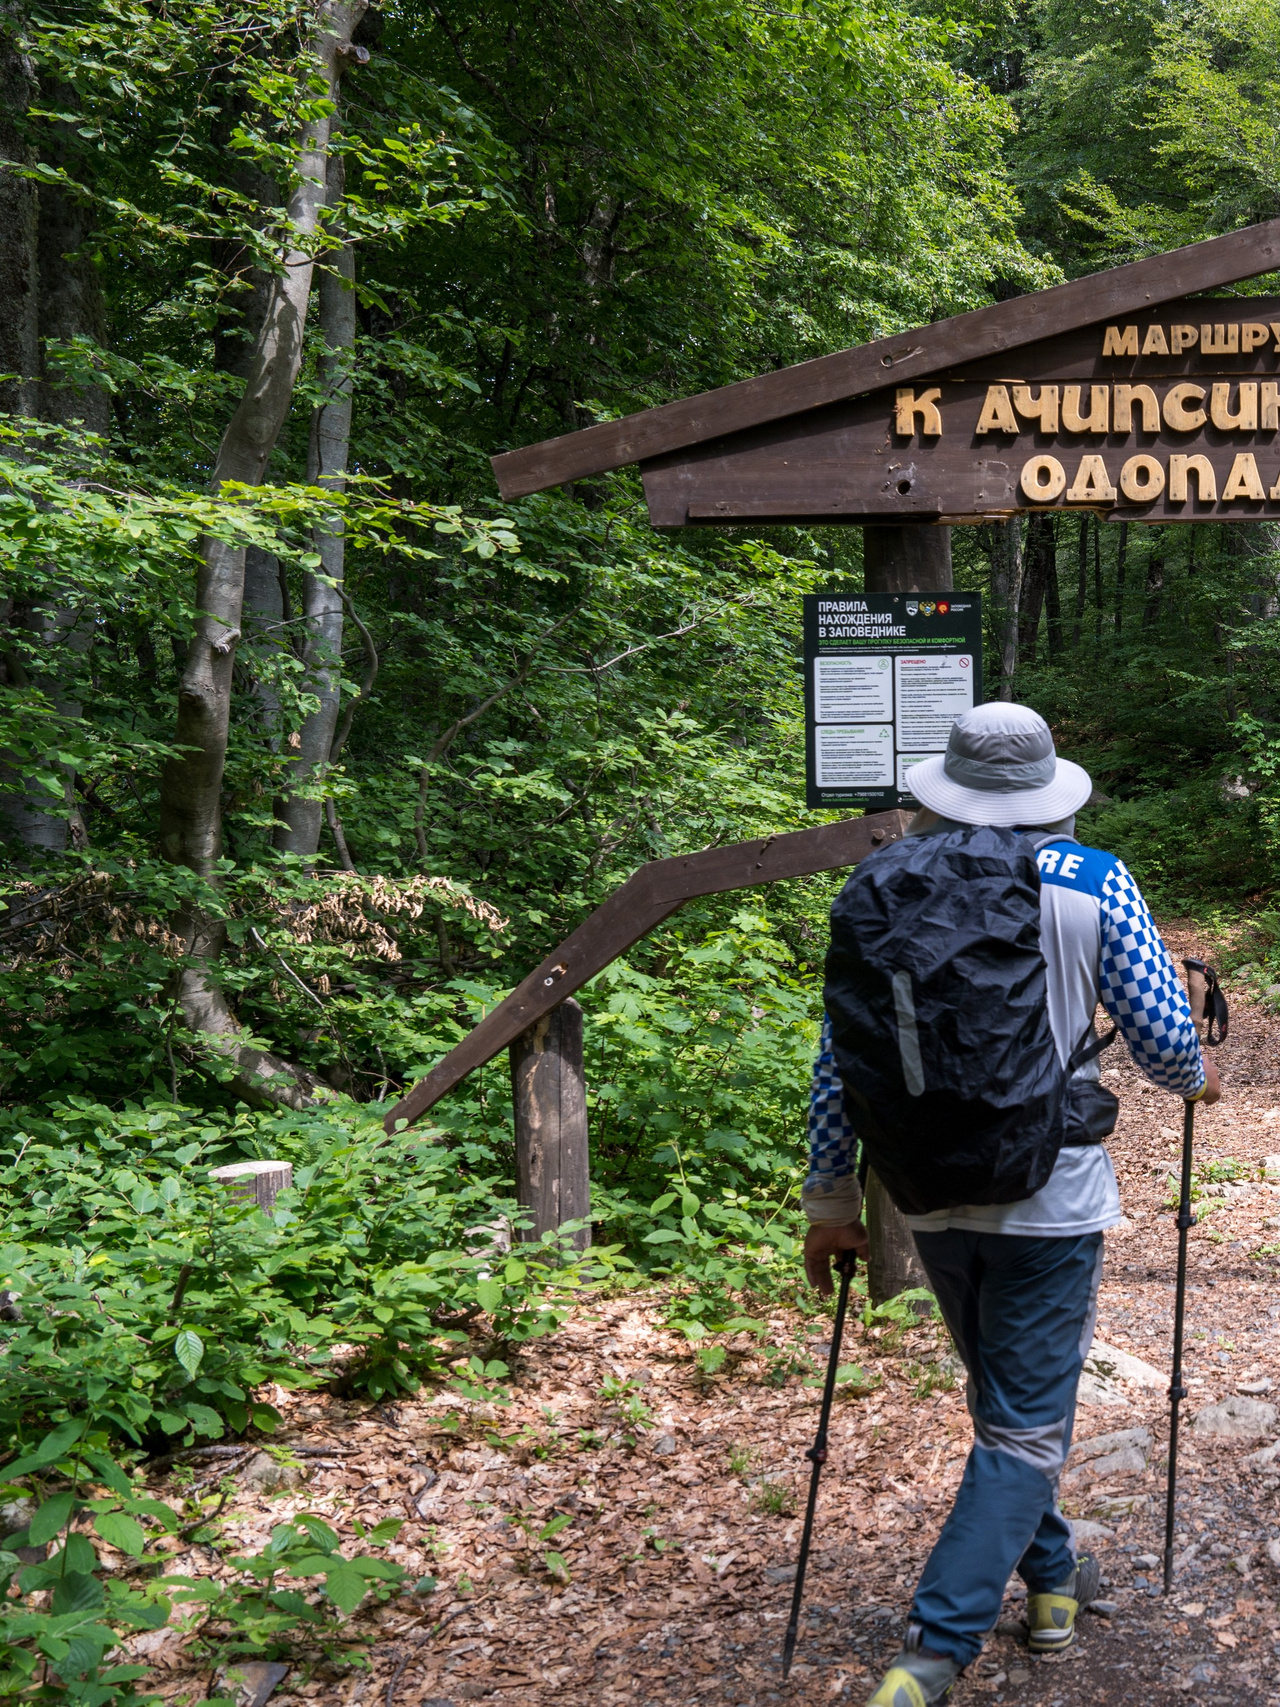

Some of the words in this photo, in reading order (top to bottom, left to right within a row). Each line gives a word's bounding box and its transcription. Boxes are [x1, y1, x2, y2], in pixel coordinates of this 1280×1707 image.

[896, 388, 942, 435] К
[818, 601, 868, 612] ПРАВИЛА
[818, 613, 892, 626] НАХОЖДЕНИЯ
[818, 627, 827, 637] В
[828, 626, 906, 638] ЗАПОВЕДНИКЕ
[1036, 849, 1084, 879] RE
